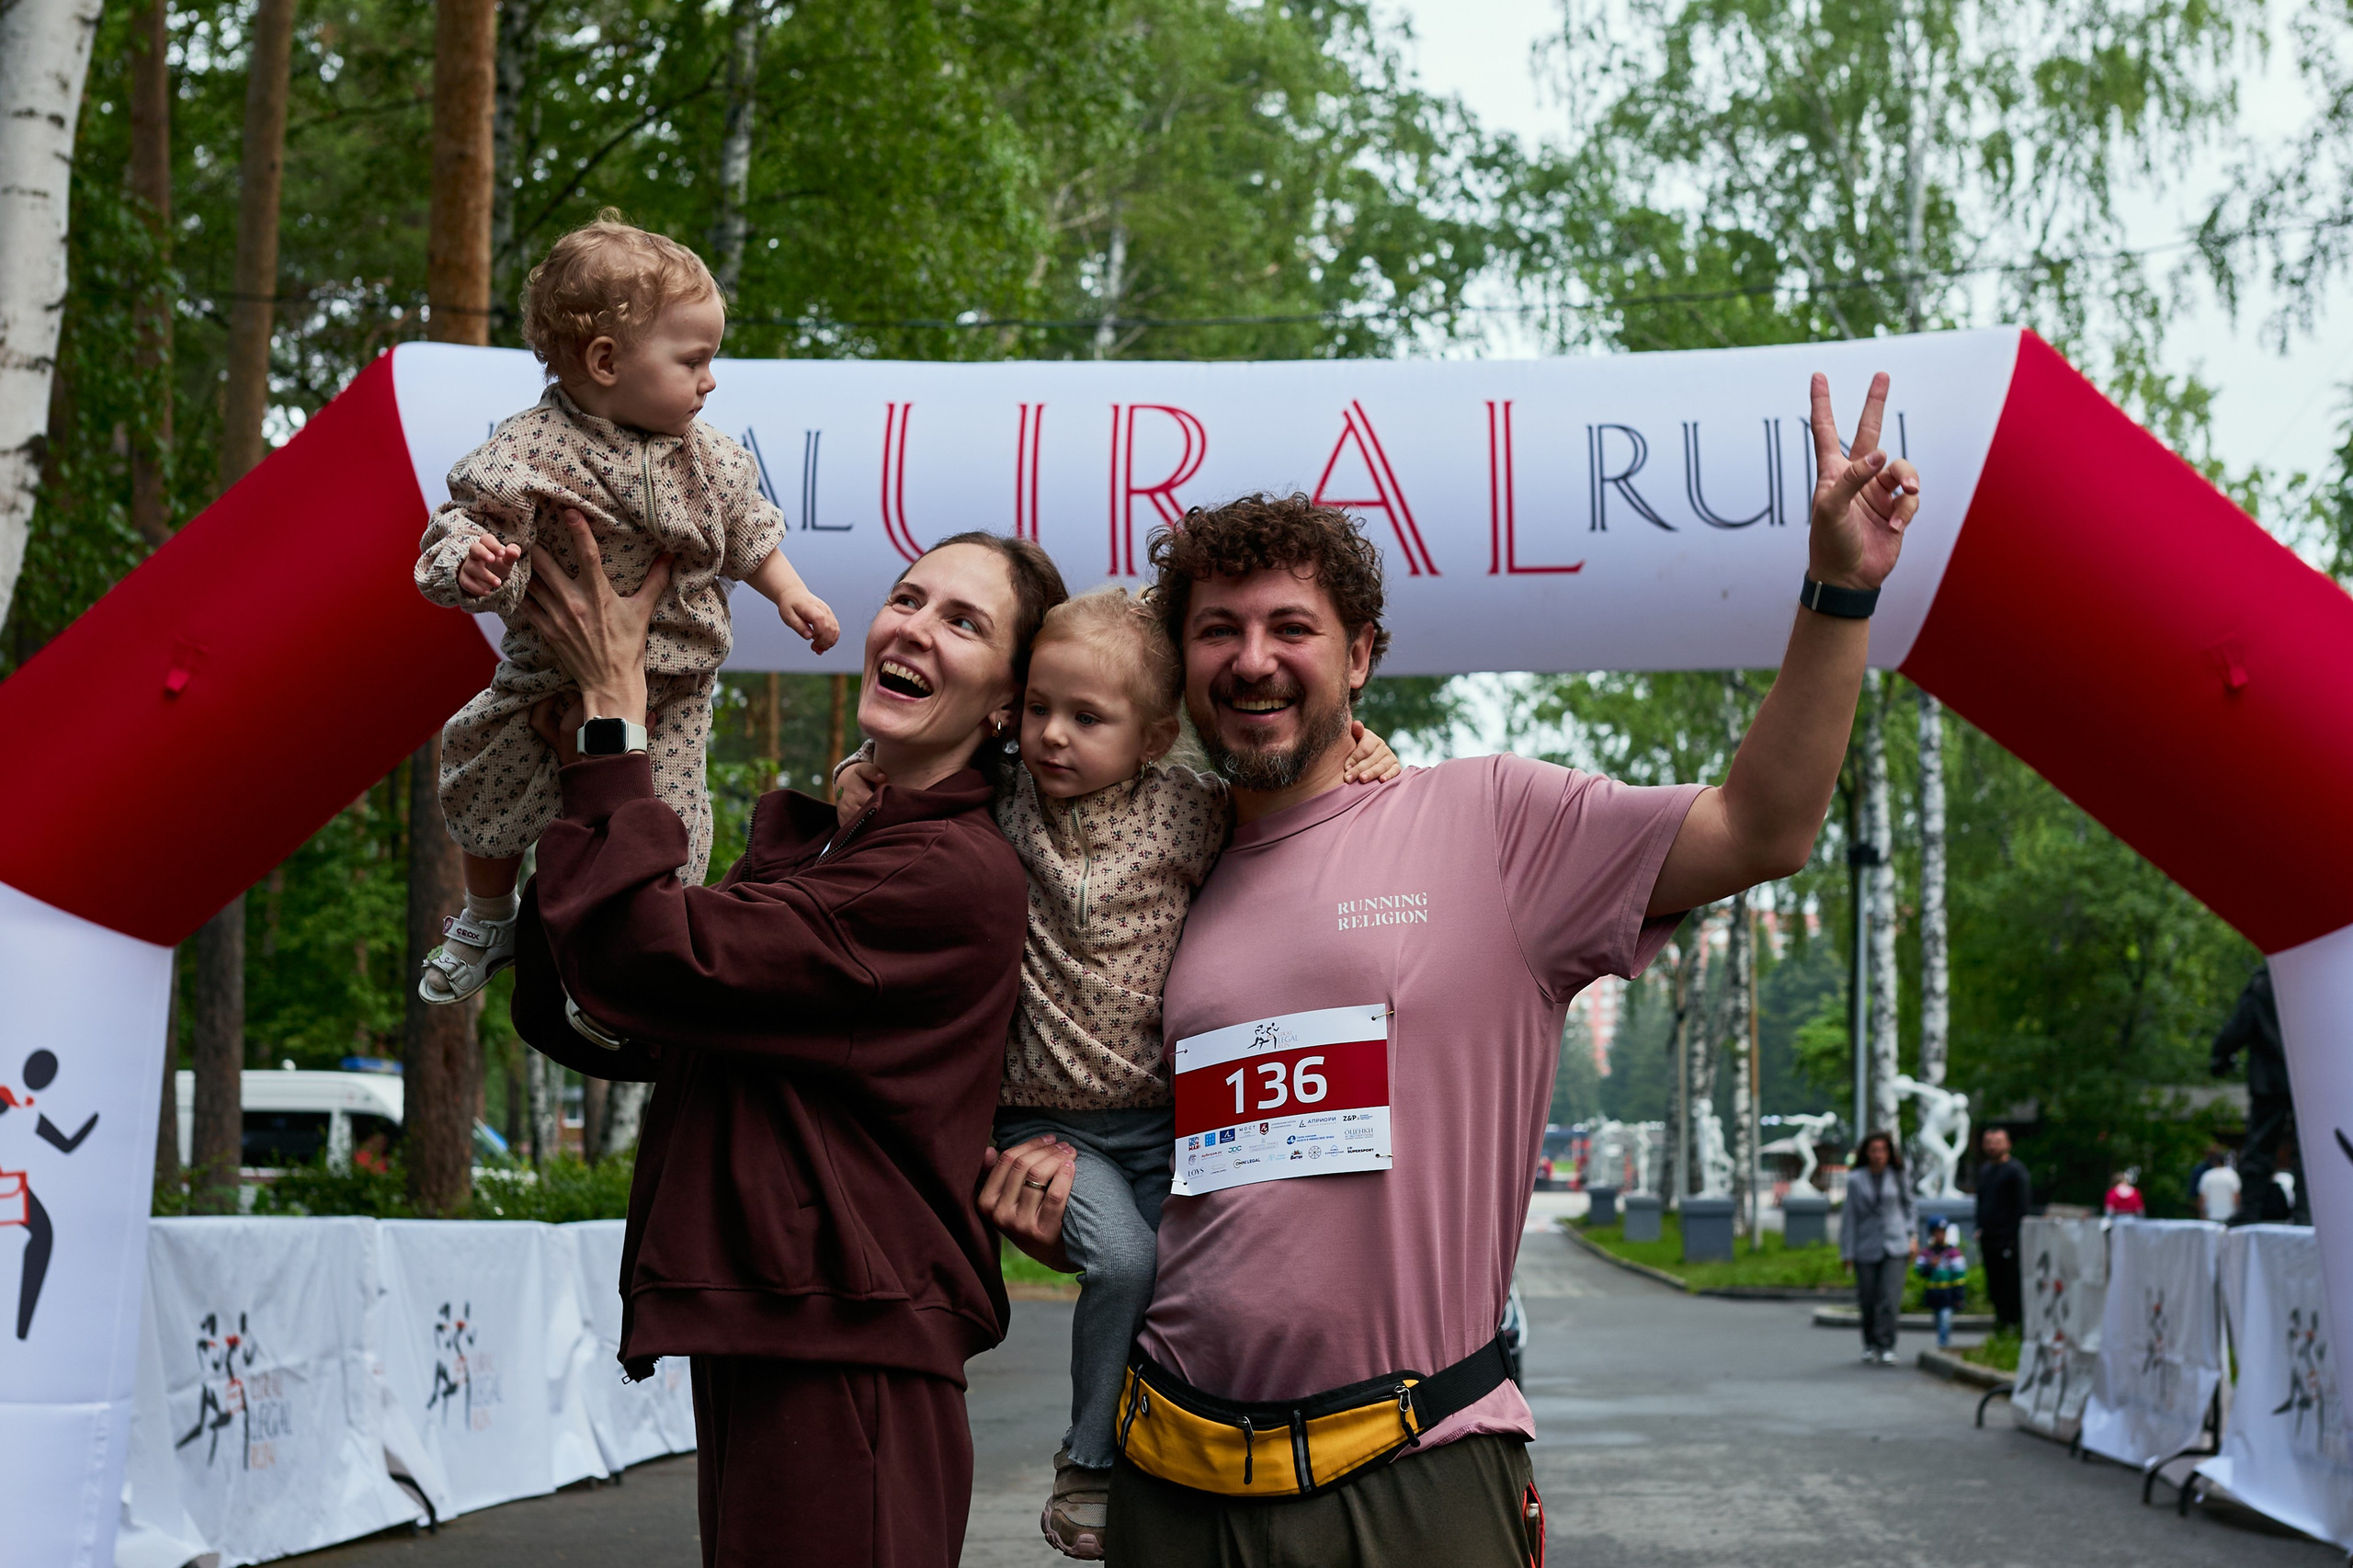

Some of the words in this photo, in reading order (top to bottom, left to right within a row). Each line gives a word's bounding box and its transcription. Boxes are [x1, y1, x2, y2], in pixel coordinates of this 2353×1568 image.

[881, 398, 1586, 578] URAL
[1337, 892, 1427, 915] RUNNING
[1337, 909, 1428, 931] RELIGION
[1278, 1035, 1299, 1044] LEGAL
[1225, 1056, 1328, 1114] 136
[1188, 1167, 1204, 1176] LOYS
